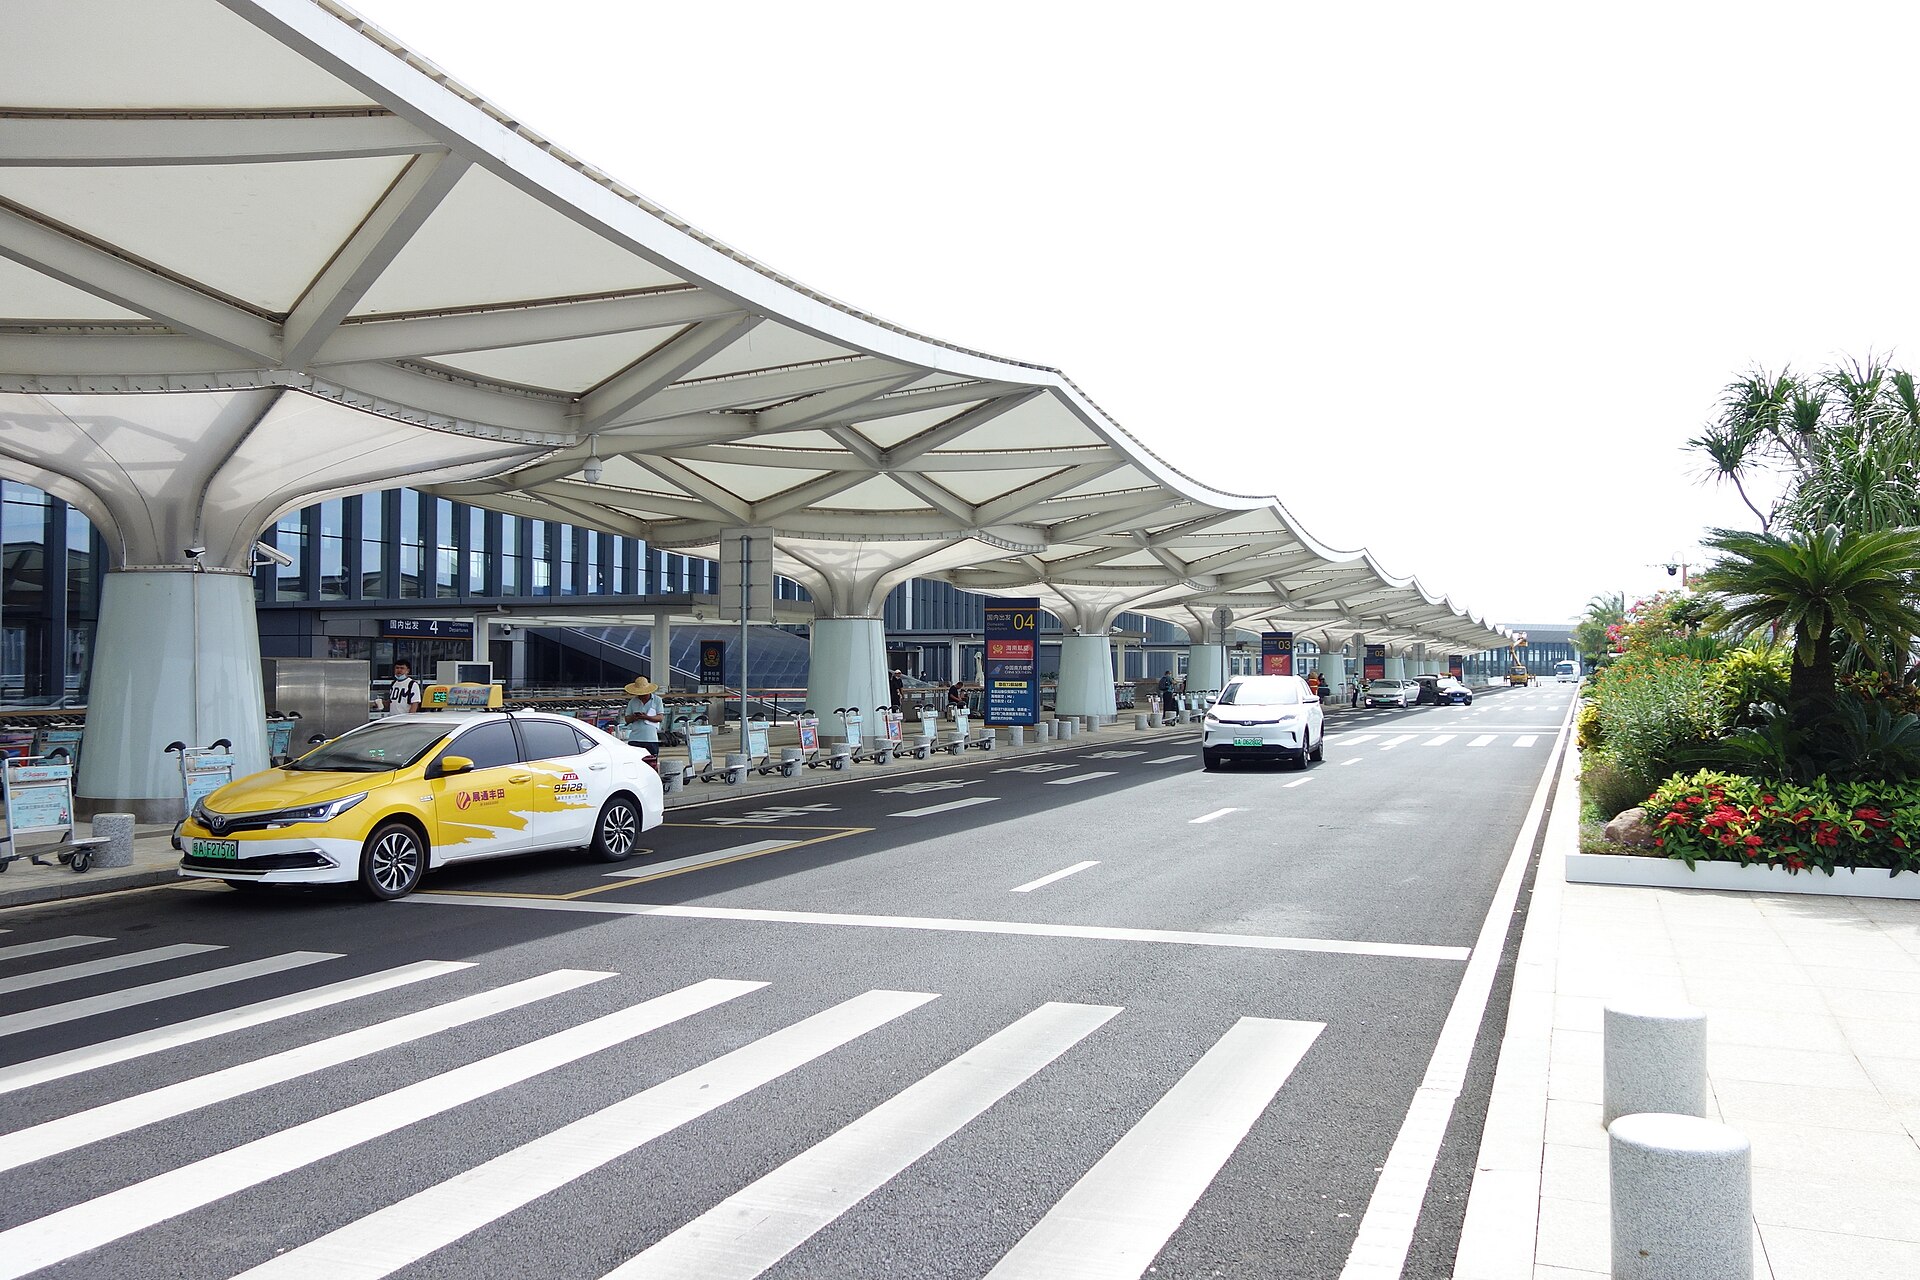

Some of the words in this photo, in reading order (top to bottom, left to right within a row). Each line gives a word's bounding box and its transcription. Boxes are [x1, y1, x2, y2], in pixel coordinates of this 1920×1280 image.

[389, 619, 419, 630] 国内出发
[1014, 613, 1035, 630] 04
[429, 620, 439, 635] 4
[1278, 640, 1291, 650] 03
[553, 782, 583, 793] 95128
